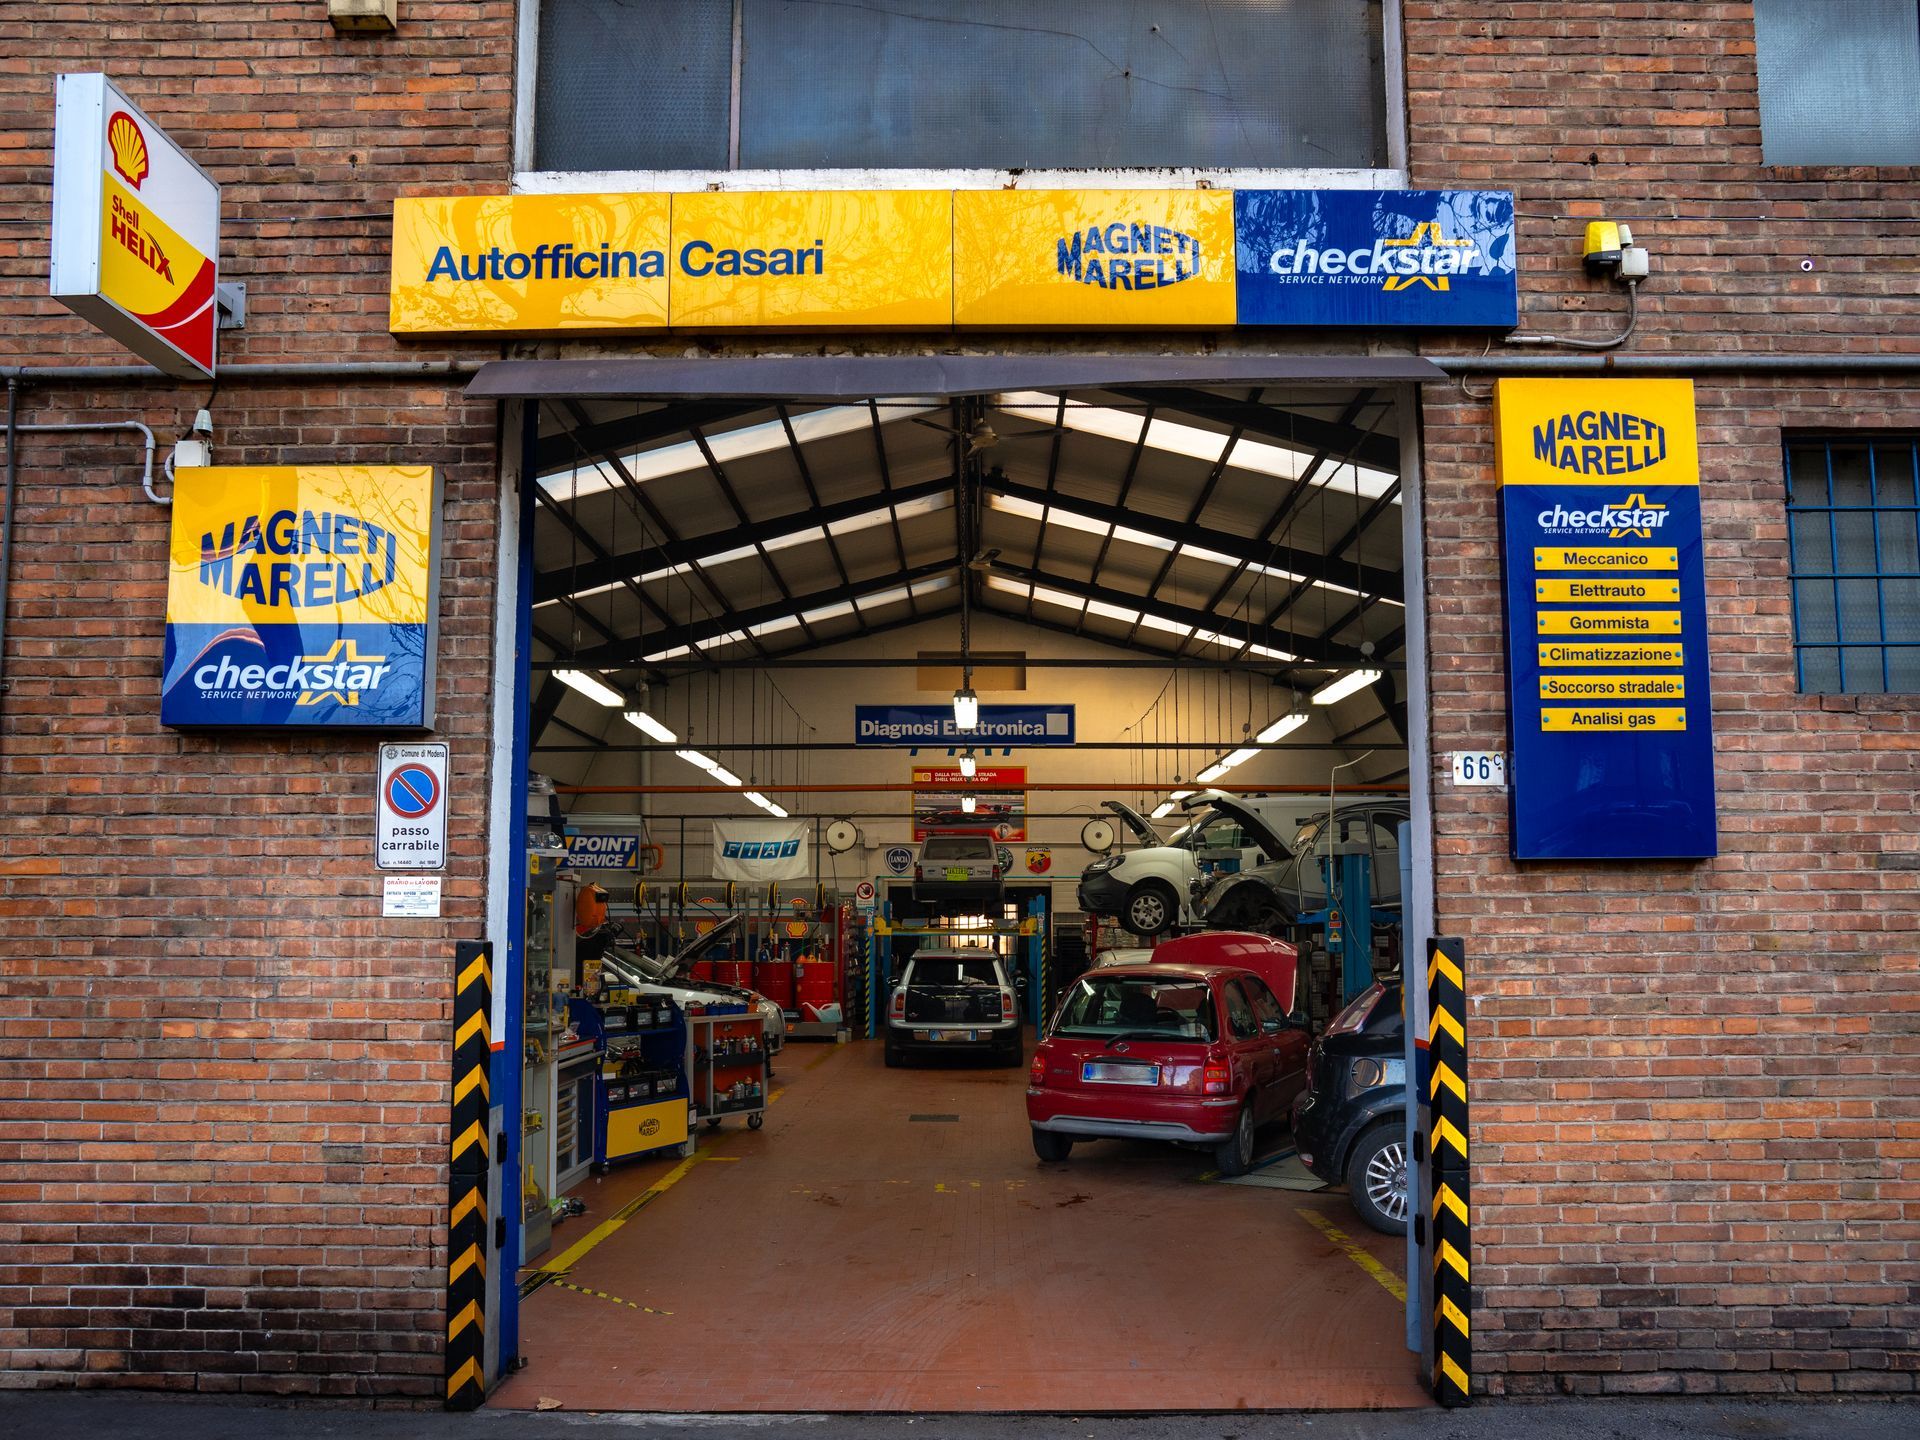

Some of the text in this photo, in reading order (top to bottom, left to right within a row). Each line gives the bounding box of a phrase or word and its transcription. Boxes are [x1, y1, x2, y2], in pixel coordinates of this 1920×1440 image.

[112, 193, 139, 229] Shell
[111, 212, 173, 285] HELIX
[1057, 222, 1199, 260] MAGNETI
[425, 239, 824, 282] Autofficina Casari
[1270, 238, 1480, 275] checkstar
[1057, 253, 1199, 291] MARELLI
[1279, 275, 1384, 285] SERVICE NETWORK
[1533, 411, 1666, 447] MAGNETI
[1533, 440, 1666, 475] MARELLI
[1537, 504, 1670, 528] checkstar
[200, 509, 396, 560] MAGNETI
[1564, 552, 1648, 565] Meccanico
[200, 554, 396, 608] MARELLI
[1570, 584, 1646, 597] Elettrauto
[1570, 616, 1649, 629] Gommista
[1550, 647, 1672, 660] Climatizzazione
[194, 655, 390, 690] checkstar
[200, 690, 300, 699] SERVICE NETWORK
[1549, 679, 1675, 693] Soccorso stradale
[1571, 712, 1656, 728] Analisi gas
[861, 720, 938, 739] Diagnosi
[401, 749, 445, 758] Comune di Modena
[392, 826, 430, 838] passo
[382, 839, 440, 851] carrabile
[574, 836, 636, 852] POINT
[725, 840, 798, 858] FIAT
[567, 853, 624, 867] SERVICE
